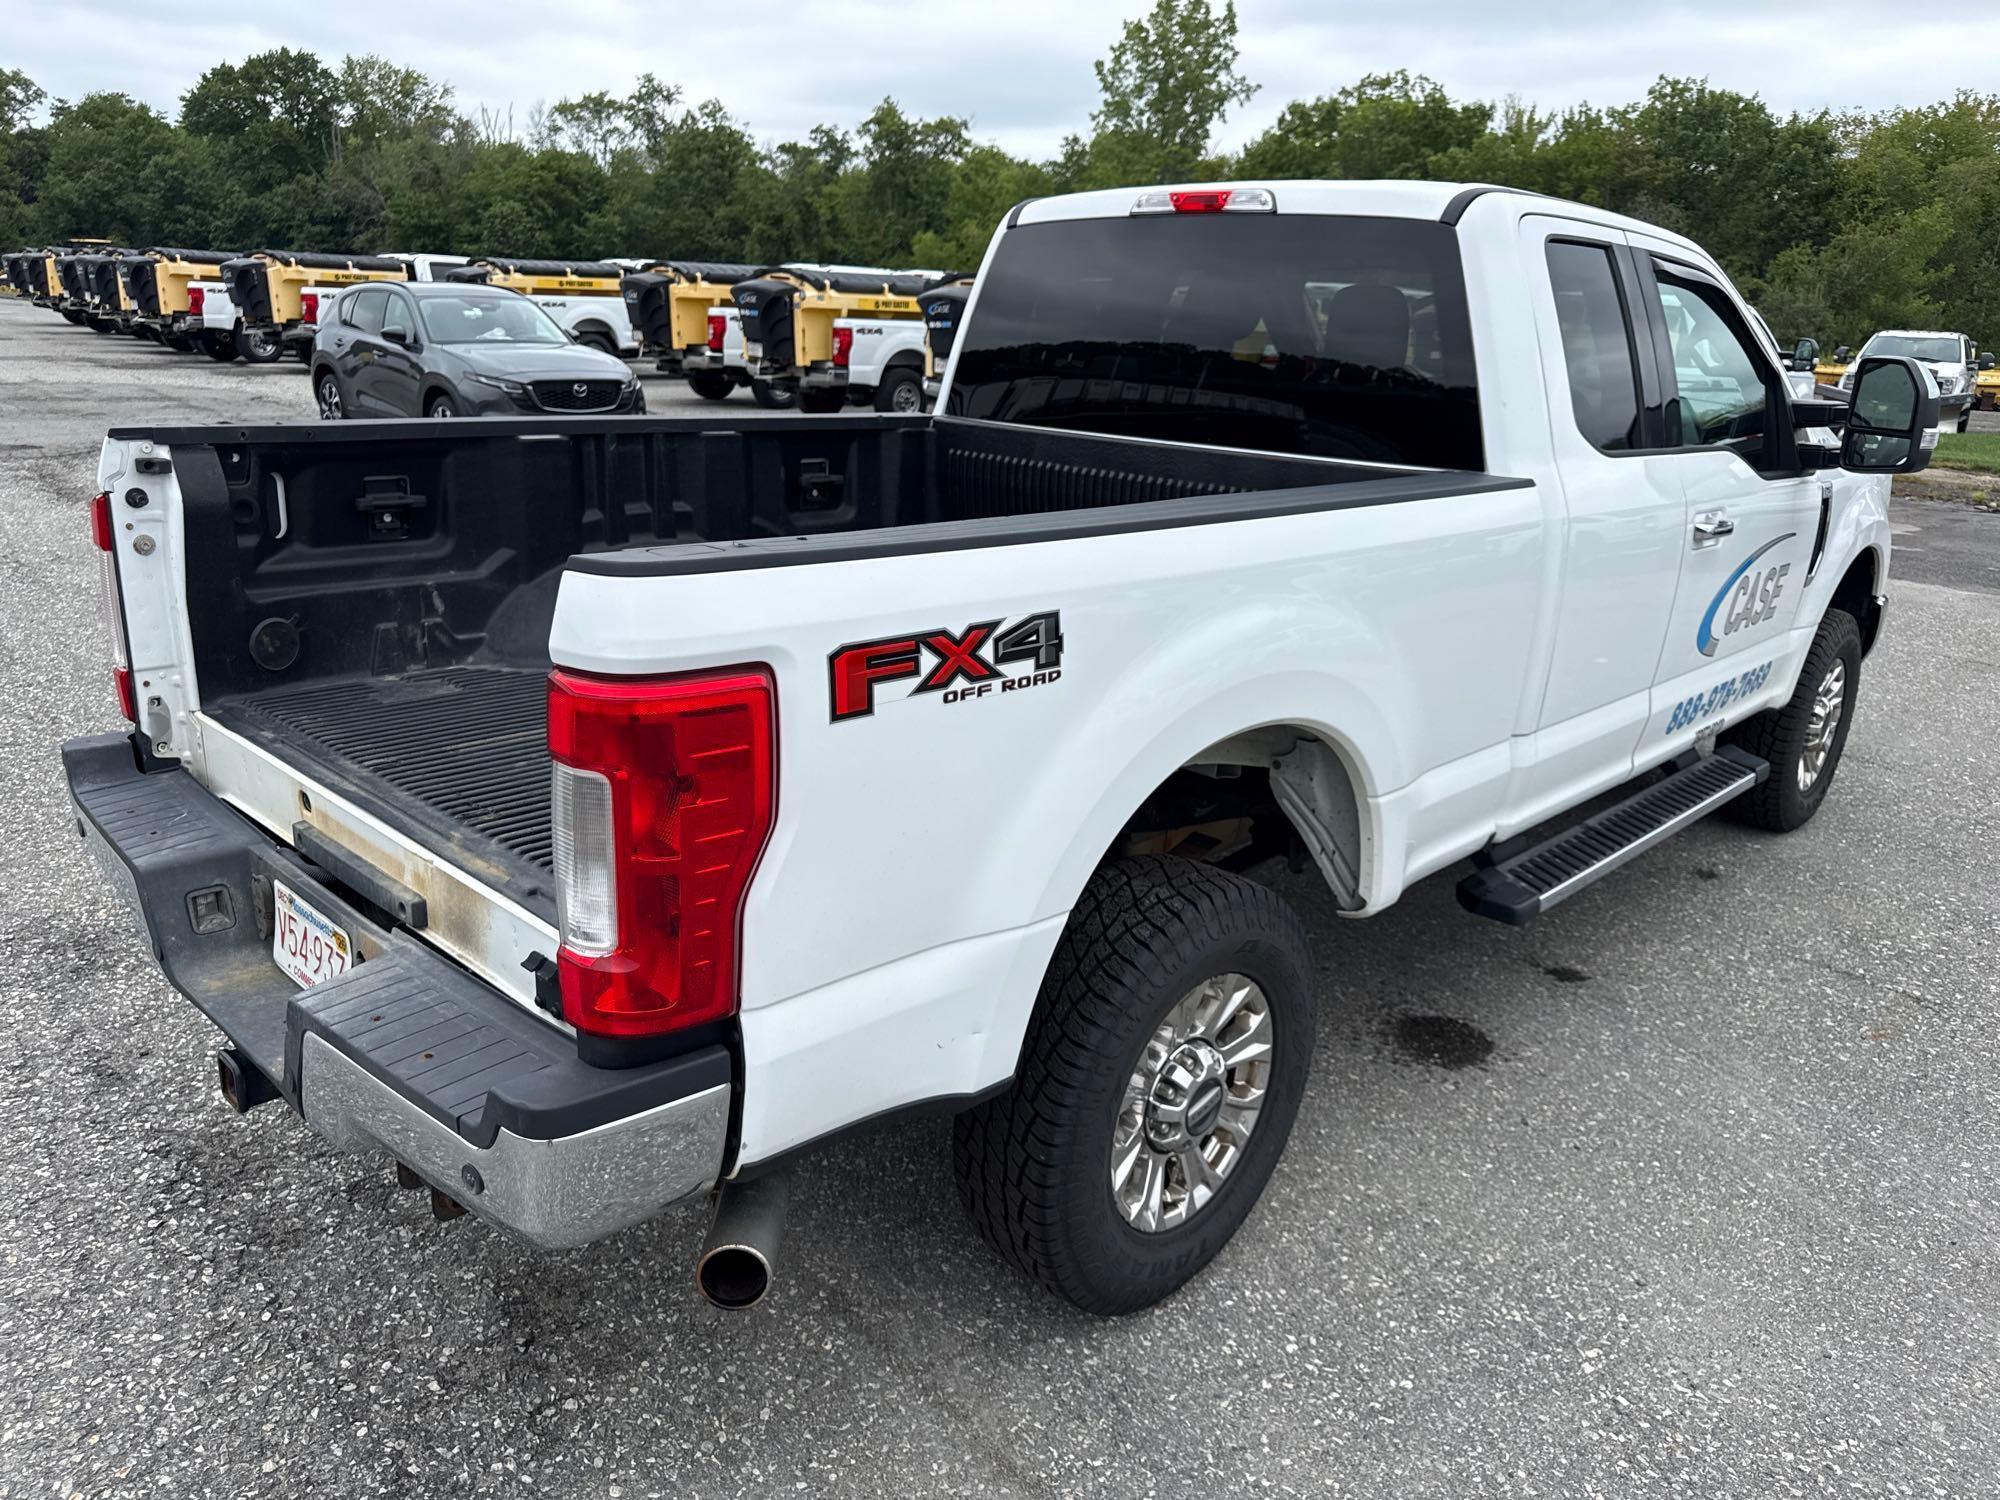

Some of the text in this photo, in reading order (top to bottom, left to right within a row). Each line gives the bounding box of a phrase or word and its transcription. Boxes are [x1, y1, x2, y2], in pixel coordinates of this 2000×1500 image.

[1724, 563, 1791, 635] CASE
[827, 609, 1064, 724] FX4
[943, 669, 1062, 704] OFF ROAD
[1665, 660, 1773, 735] 888-978-7669
